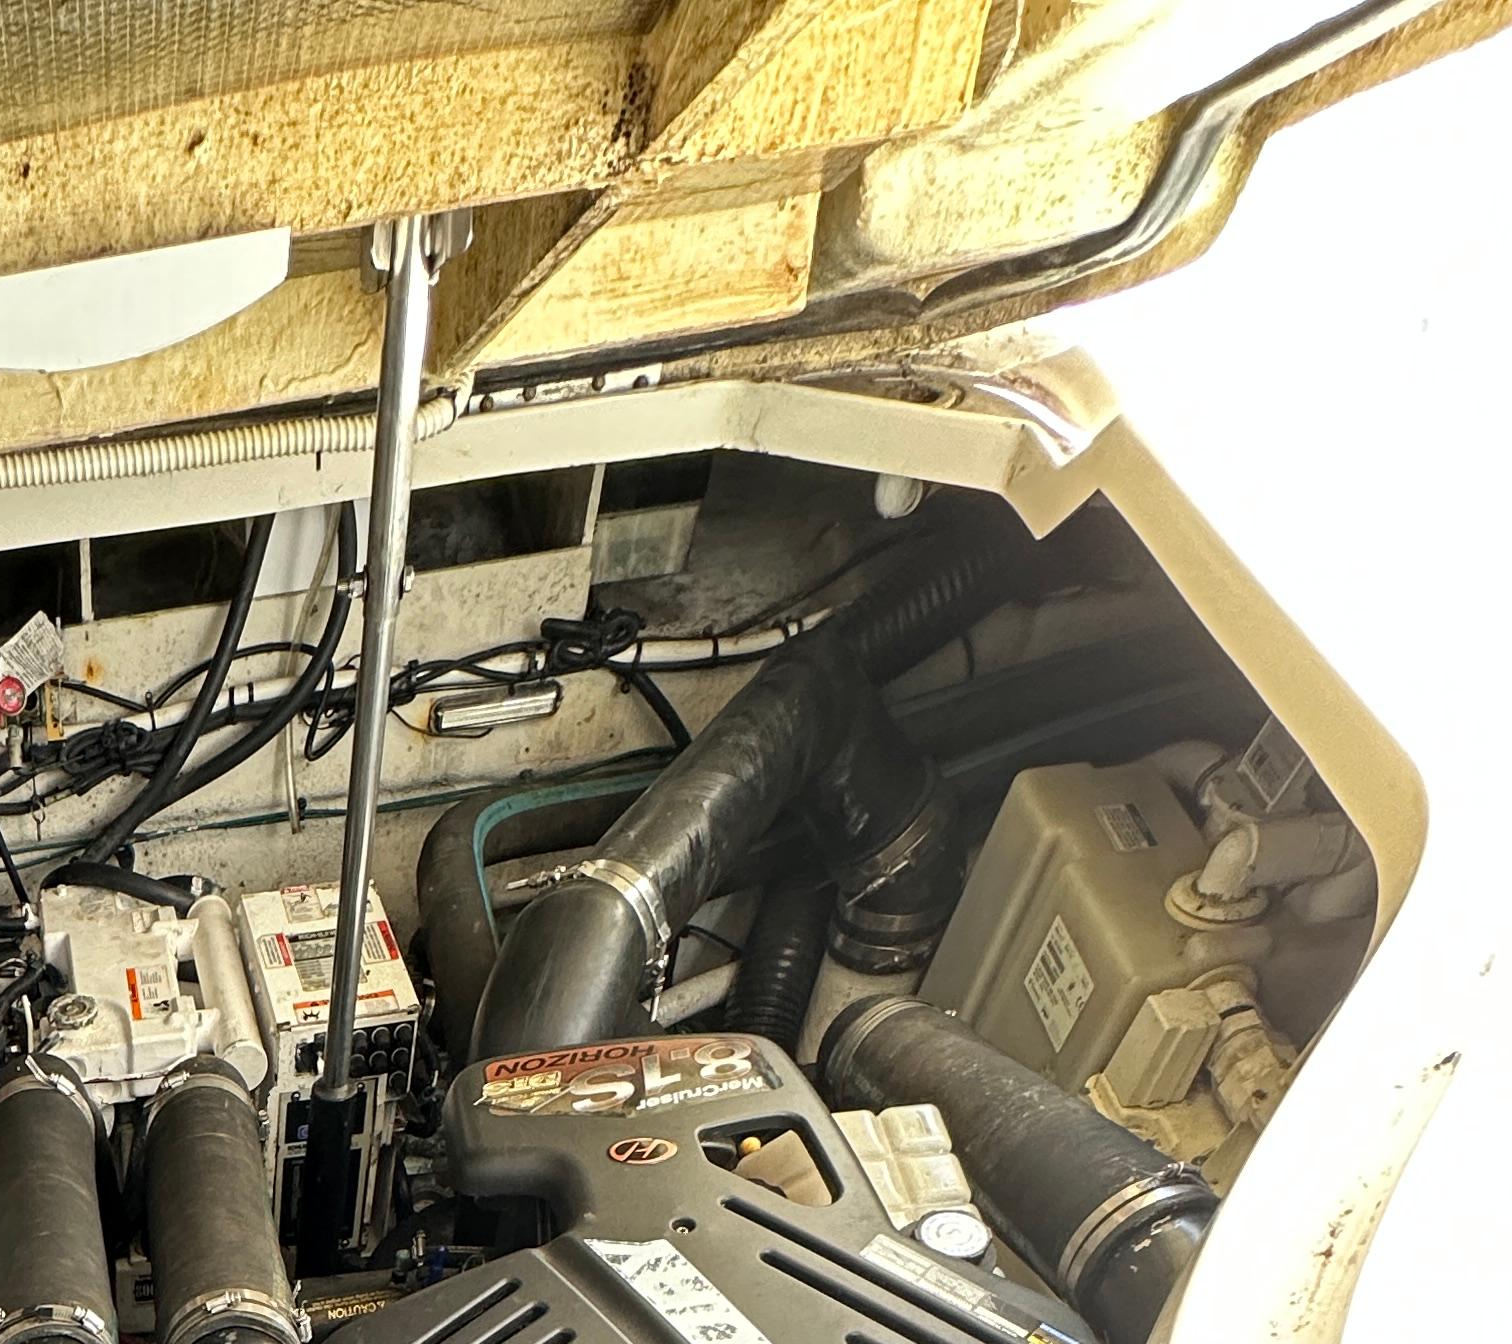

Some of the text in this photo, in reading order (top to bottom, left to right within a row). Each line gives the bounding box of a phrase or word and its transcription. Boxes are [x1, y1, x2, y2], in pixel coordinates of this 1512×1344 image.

[494, 1044, 656, 1077] HORIZON
[571, 1039, 753, 1112] 8.1S
[636, 1075, 764, 1111] MerCruiser
